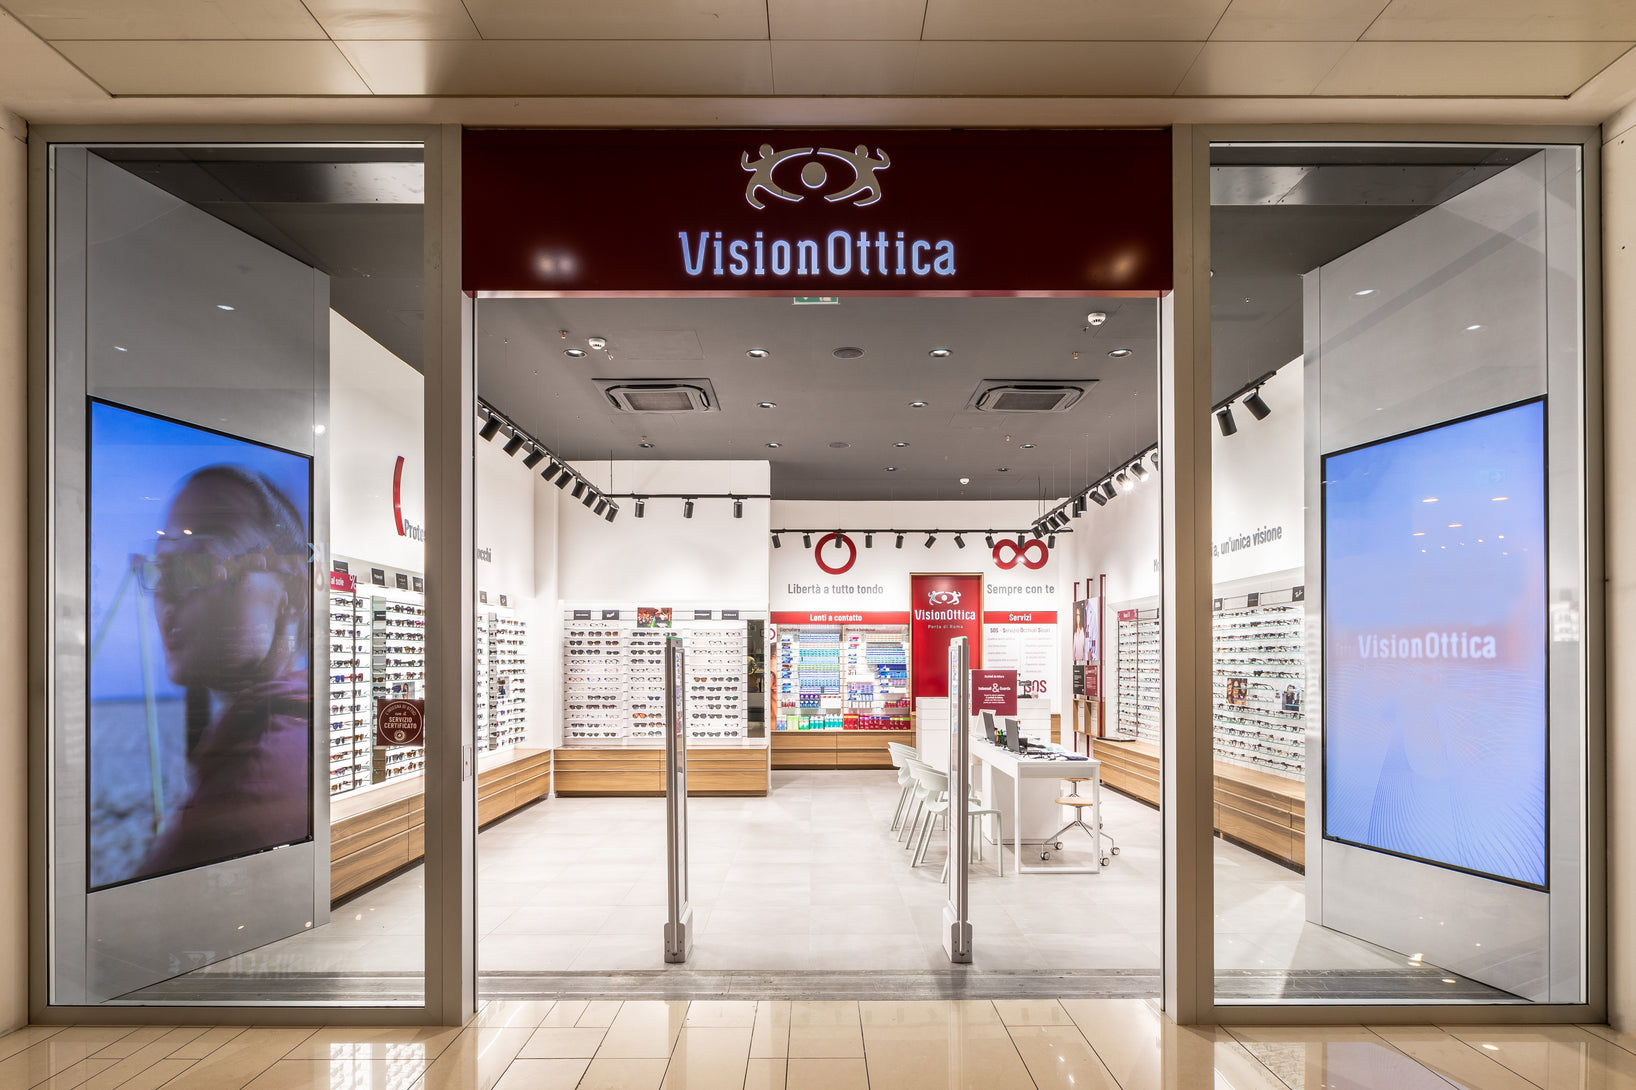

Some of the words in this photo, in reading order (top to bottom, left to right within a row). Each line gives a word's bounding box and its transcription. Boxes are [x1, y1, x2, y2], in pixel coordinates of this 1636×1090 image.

[678, 230, 957, 277] VisionOttica
[404, 518, 424, 542] Prote
[1220, 533, 1251, 555] un'unica
[1252, 525, 1283, 547] visione
[787, 583, 821, 594] Libertà
[823, 586, 830, 594] a
[831, 584, 855, 594] tutto
[857, 583, 884, 594] tondo
[986, 583, 1023, 596] Sempre
[1025, 585, 1043, 594] con
[1045, 584, 1055, 594] te
[809, 613, 827, 622] Lenti
[834, 613, 863, 622] contatto
[914, 609, 976, 620] VisionOttica
[1008, 613, 1032, 622] Servizi
[1358, 632, 1497, 659] VisionOttica
